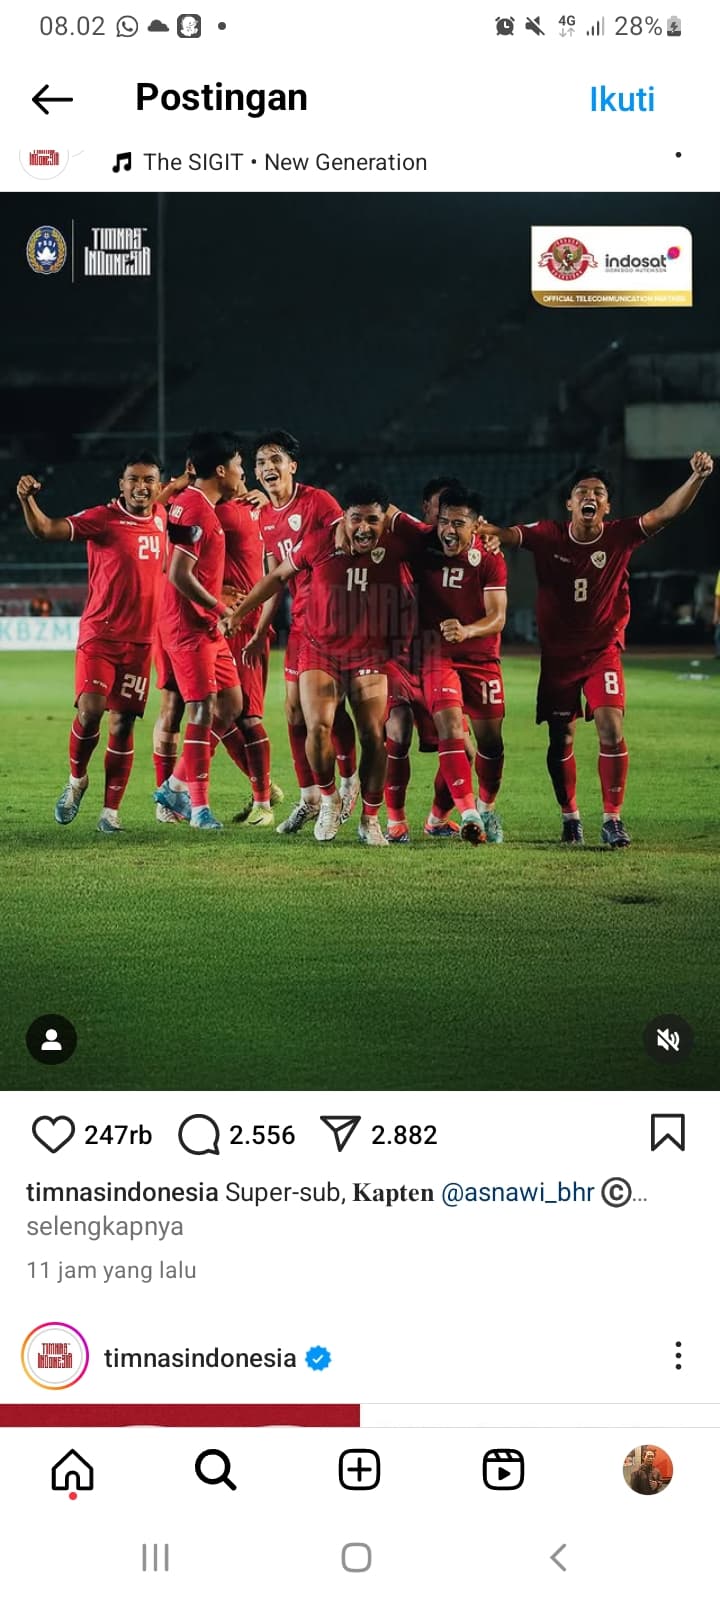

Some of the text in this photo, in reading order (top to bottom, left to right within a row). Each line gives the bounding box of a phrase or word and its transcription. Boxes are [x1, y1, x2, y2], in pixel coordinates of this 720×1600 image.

[40, 16, 105, 35] 08.02
[559, 15, 575, 25] 4G
[615, 16, 662, 35] 28%
[137, 82, 307, 118] Postingan
[591, 85, 654, 112] Ikuti
[144, 153, 426, 170] The SIGIT New Generation
[138, 535, 160, 560] 24
[346, 567, 369, 592] 14
[441, 566, 465, 589] 12
[573, 578, 587, 602] 8
[121, 673, 147, 701] 24
[480, 679, 503, 704] 12
[604, 671, 619, 695] 8
[85, 1124, 152, 1144] 247rb
[230, 1125, 295, 1144] 2.556
[372, 1125, 437, 1144] 2.882
[26, 1181, 218, 1201] timnasindonesia
[226, 1181, 345, 1207] Super-sub,
[352, 1183, 434, 1207] Kapten
[442, 1181, 595, 1207] @asnawi_bhr
[27, 1216, 183, 1241] selengkapnya
[28, 1261, 195, 1283] 11 jam yang lalu
[104, 1347, 296, 1367] timnasindonesia
